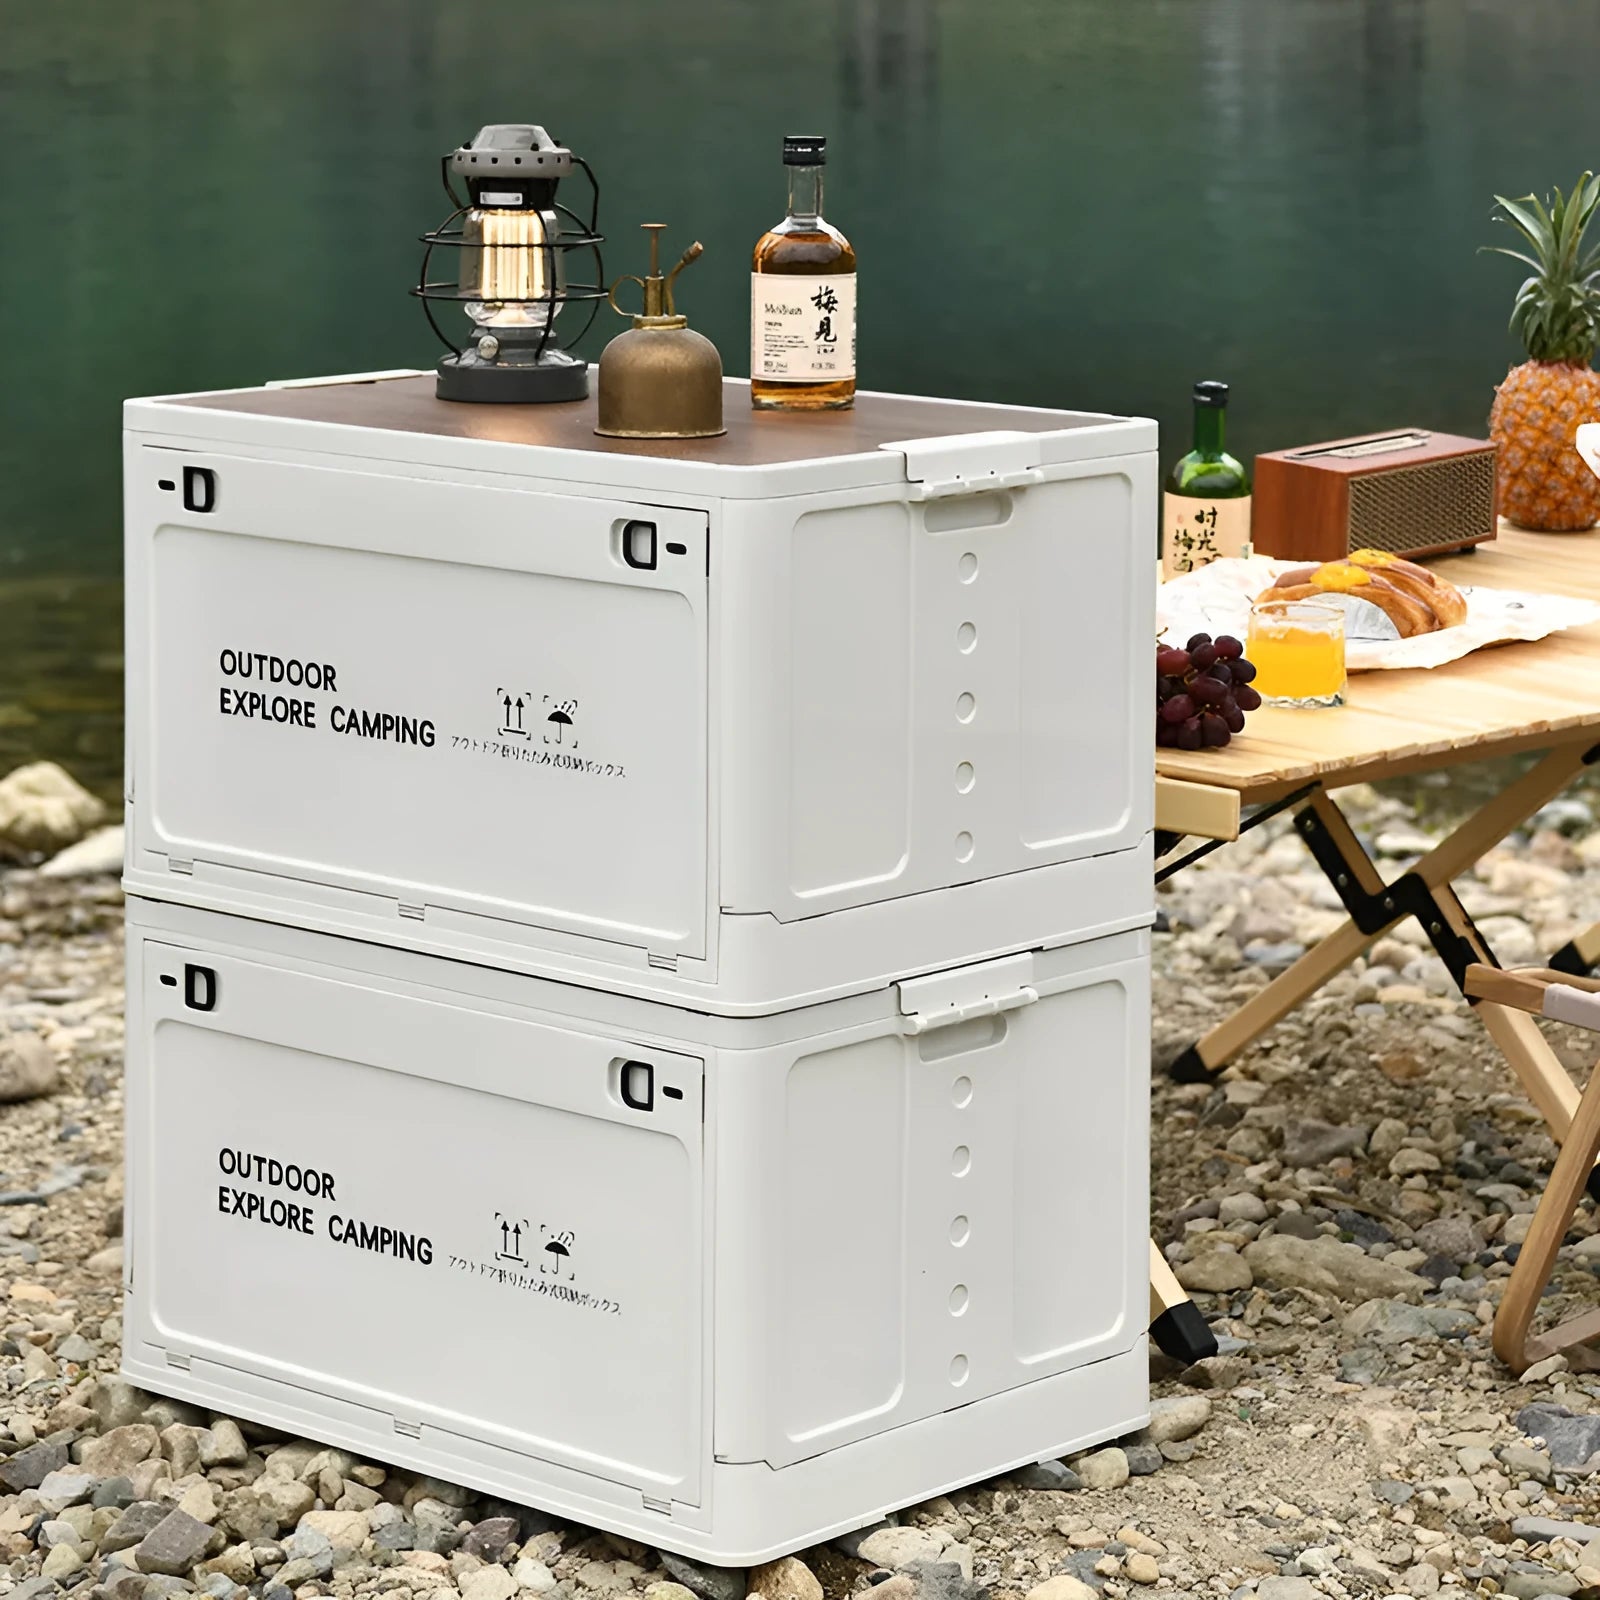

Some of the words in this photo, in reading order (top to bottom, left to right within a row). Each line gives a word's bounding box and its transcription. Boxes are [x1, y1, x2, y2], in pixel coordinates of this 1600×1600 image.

[219, 648, 338, 692] OUTDOOR
[219, 687, 317, 729] EXPLORE
[330, 705, 436, 748] CAMPING
[218, 1147, 336, 1202] OUTDOOR
[218, 1185, 315, 1236] EXPLORE
[328, 1214, 433, 1266] CAMPING
